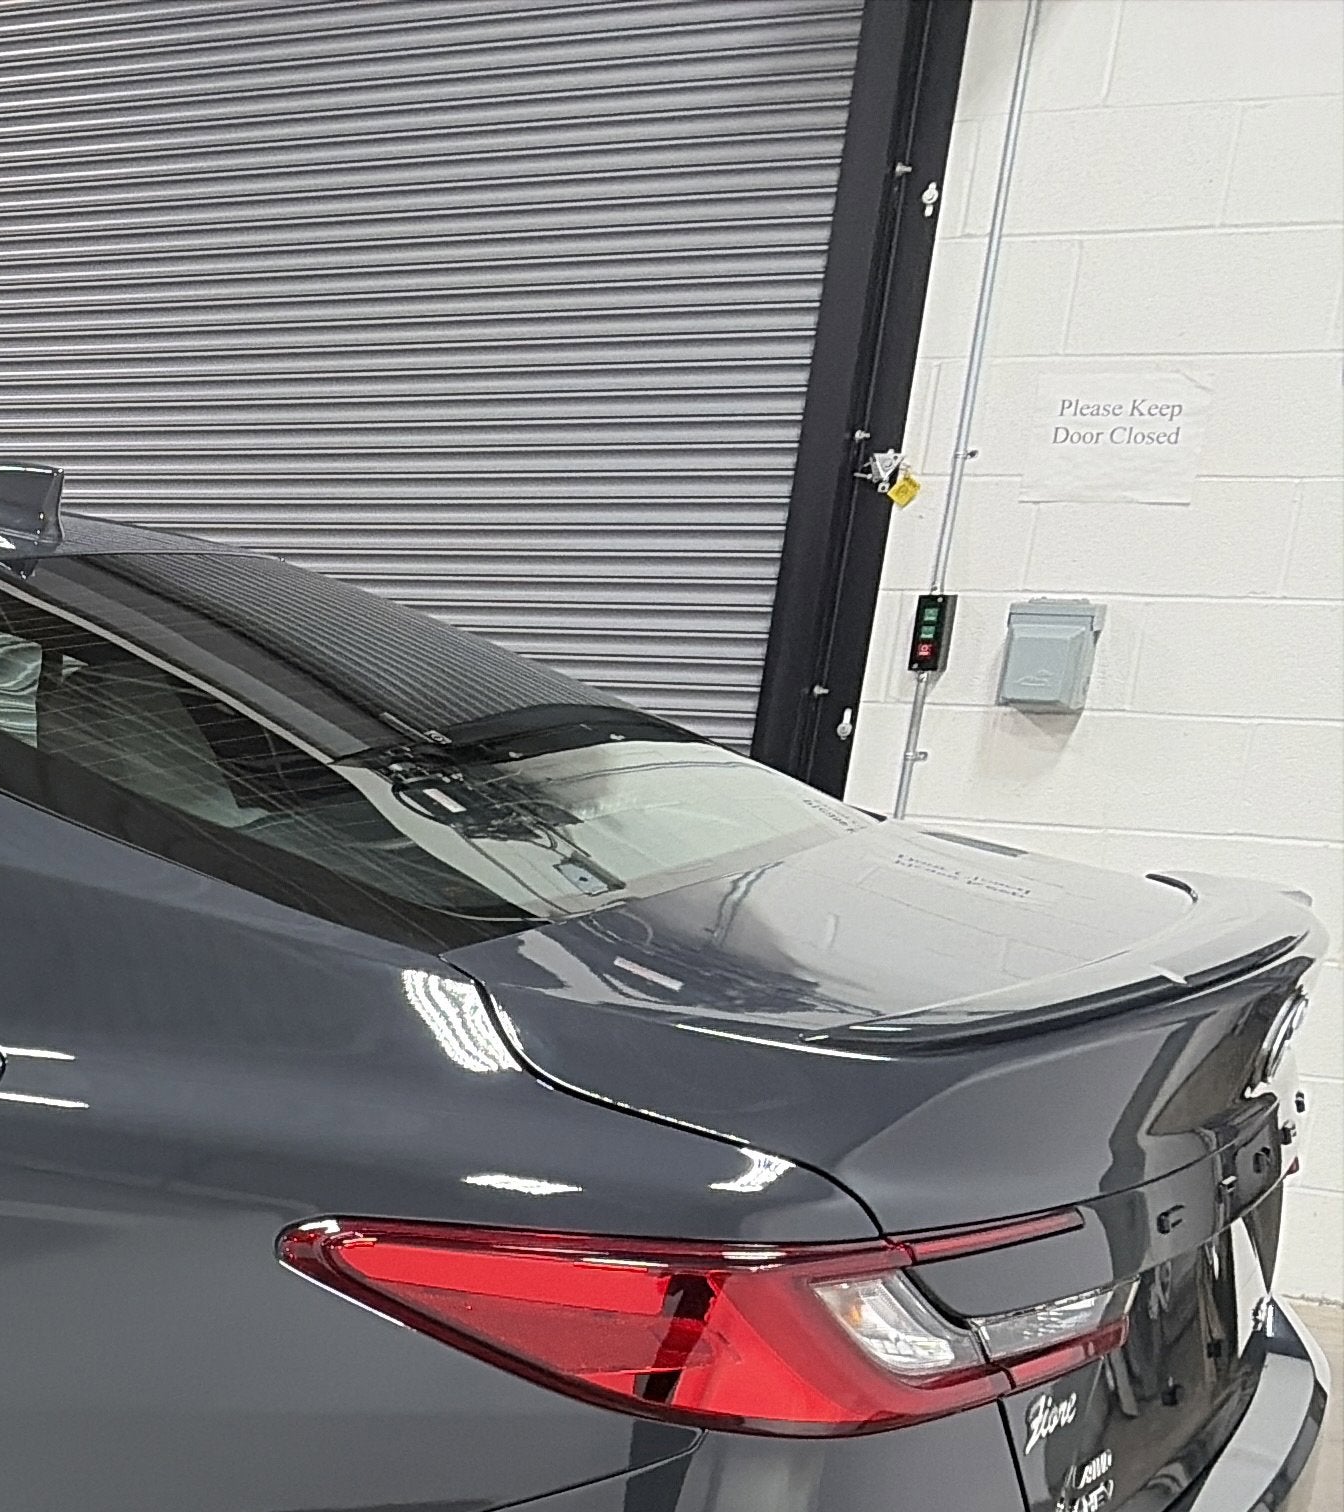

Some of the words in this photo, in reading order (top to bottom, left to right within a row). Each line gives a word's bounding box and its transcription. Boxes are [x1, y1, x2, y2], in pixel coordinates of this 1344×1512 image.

[1058, 399, 1124, 418] Please
[1128, 398, 1184, 422] Keep
[1052, 426, 1105, 445] Door
[1109, 426, 1181, 445] Closed
[1024, 1392, 1077, 1456] Fiore
